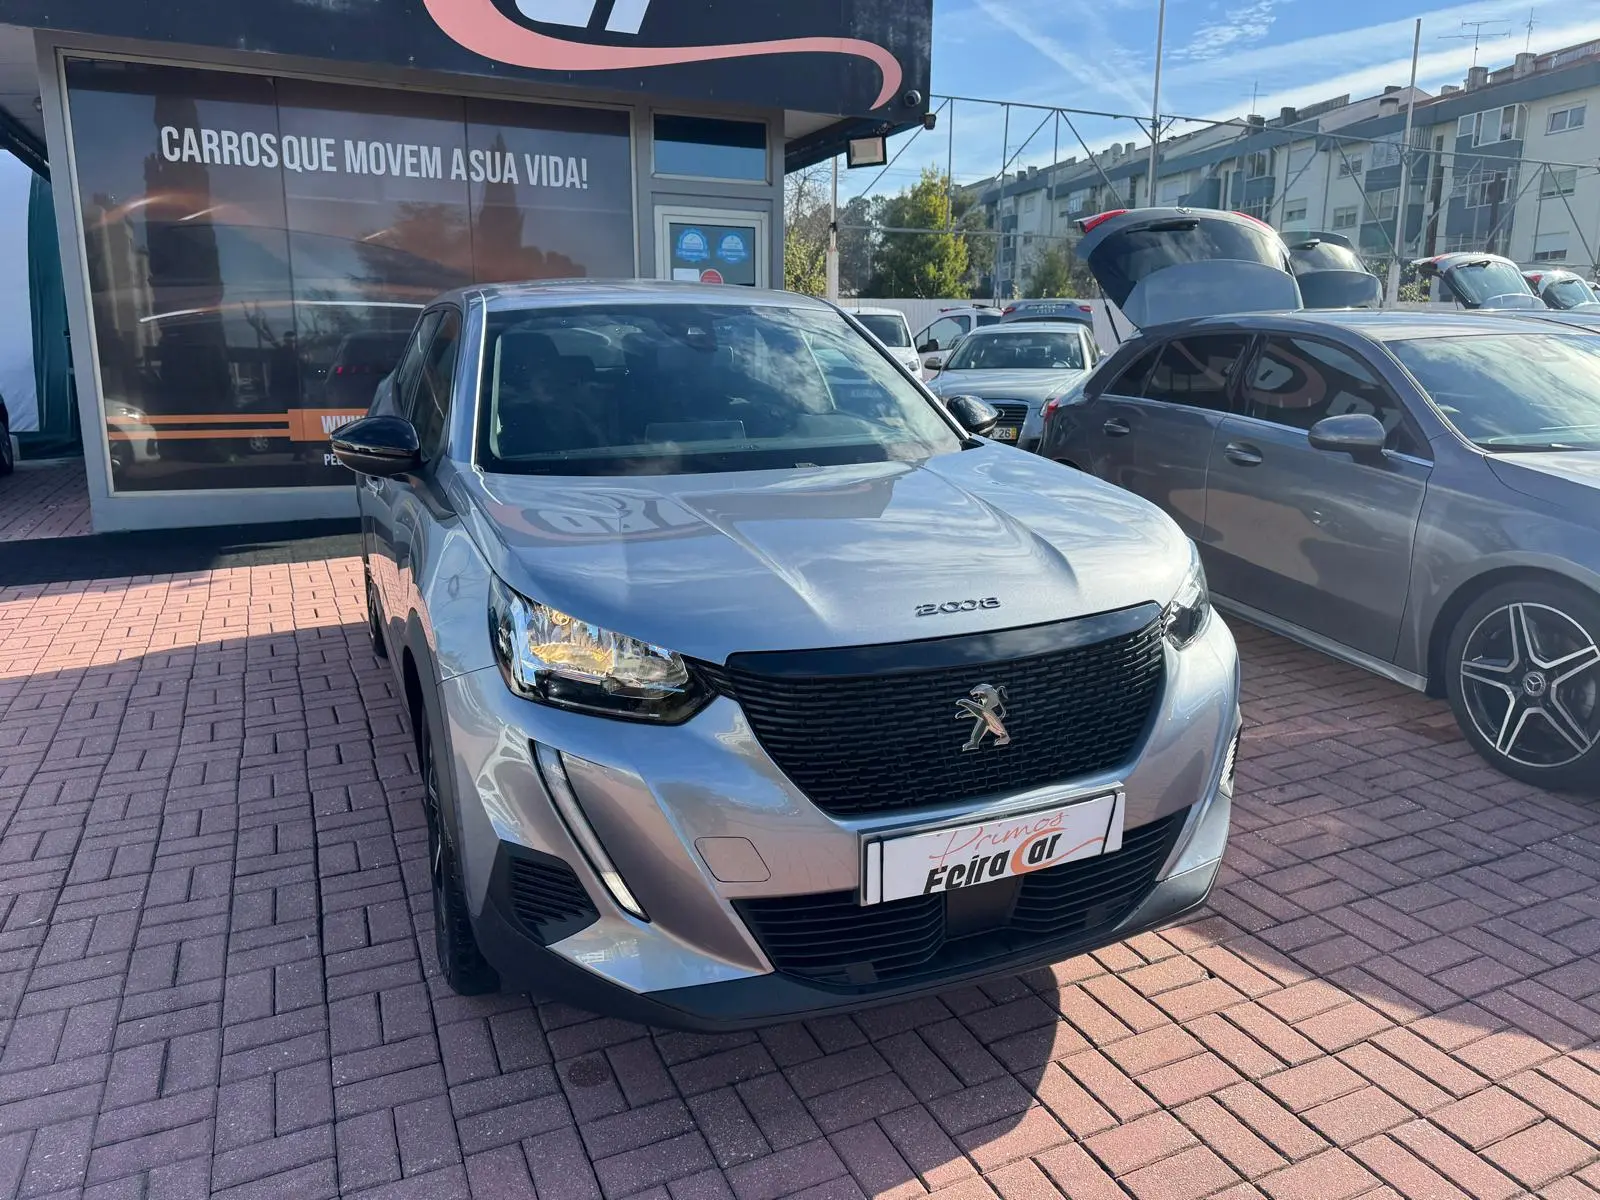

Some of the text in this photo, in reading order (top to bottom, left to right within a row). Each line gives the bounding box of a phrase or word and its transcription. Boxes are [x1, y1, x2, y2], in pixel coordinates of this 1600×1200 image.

[161, 126, 589, 190] CARROS QUE MOVEM A SUA VIDA!
[914, 597, 1001, 618] 2008
[929, 812, 1069, 872] Primos
